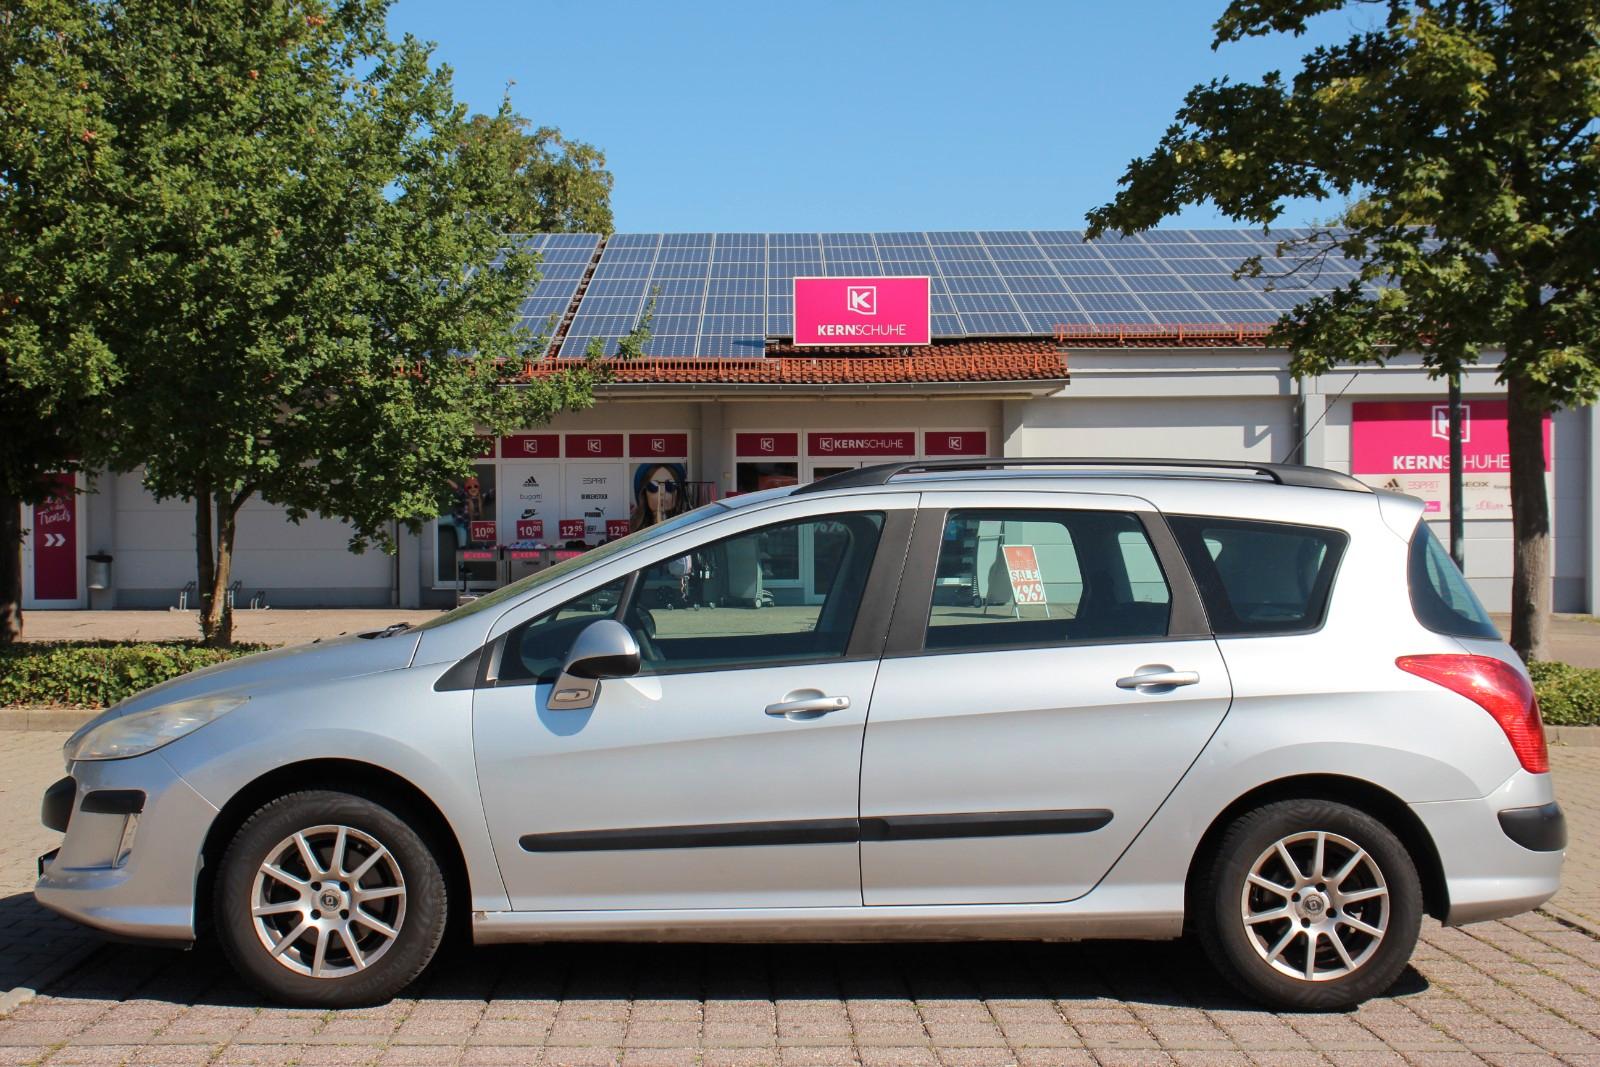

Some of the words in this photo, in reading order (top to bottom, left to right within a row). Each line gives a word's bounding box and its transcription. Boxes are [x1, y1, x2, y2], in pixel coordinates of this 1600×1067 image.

[817, 324, 907, 336] KERNSCHUHE
[834, 439, 904, 449] KERNSCHUHE
[1393, 454, 1511, 470] KERNSHUHE
[582, 477, 607, 485] ESPRIT
[1408, 480, 1440, 490] ESPRIT
[1462, 480, 1489, 488] EOX
[519, 492, 543, 501] bugatti
[562, 525, 583, 537] 12,95
[1011, 570, 1040, 581] SALE
